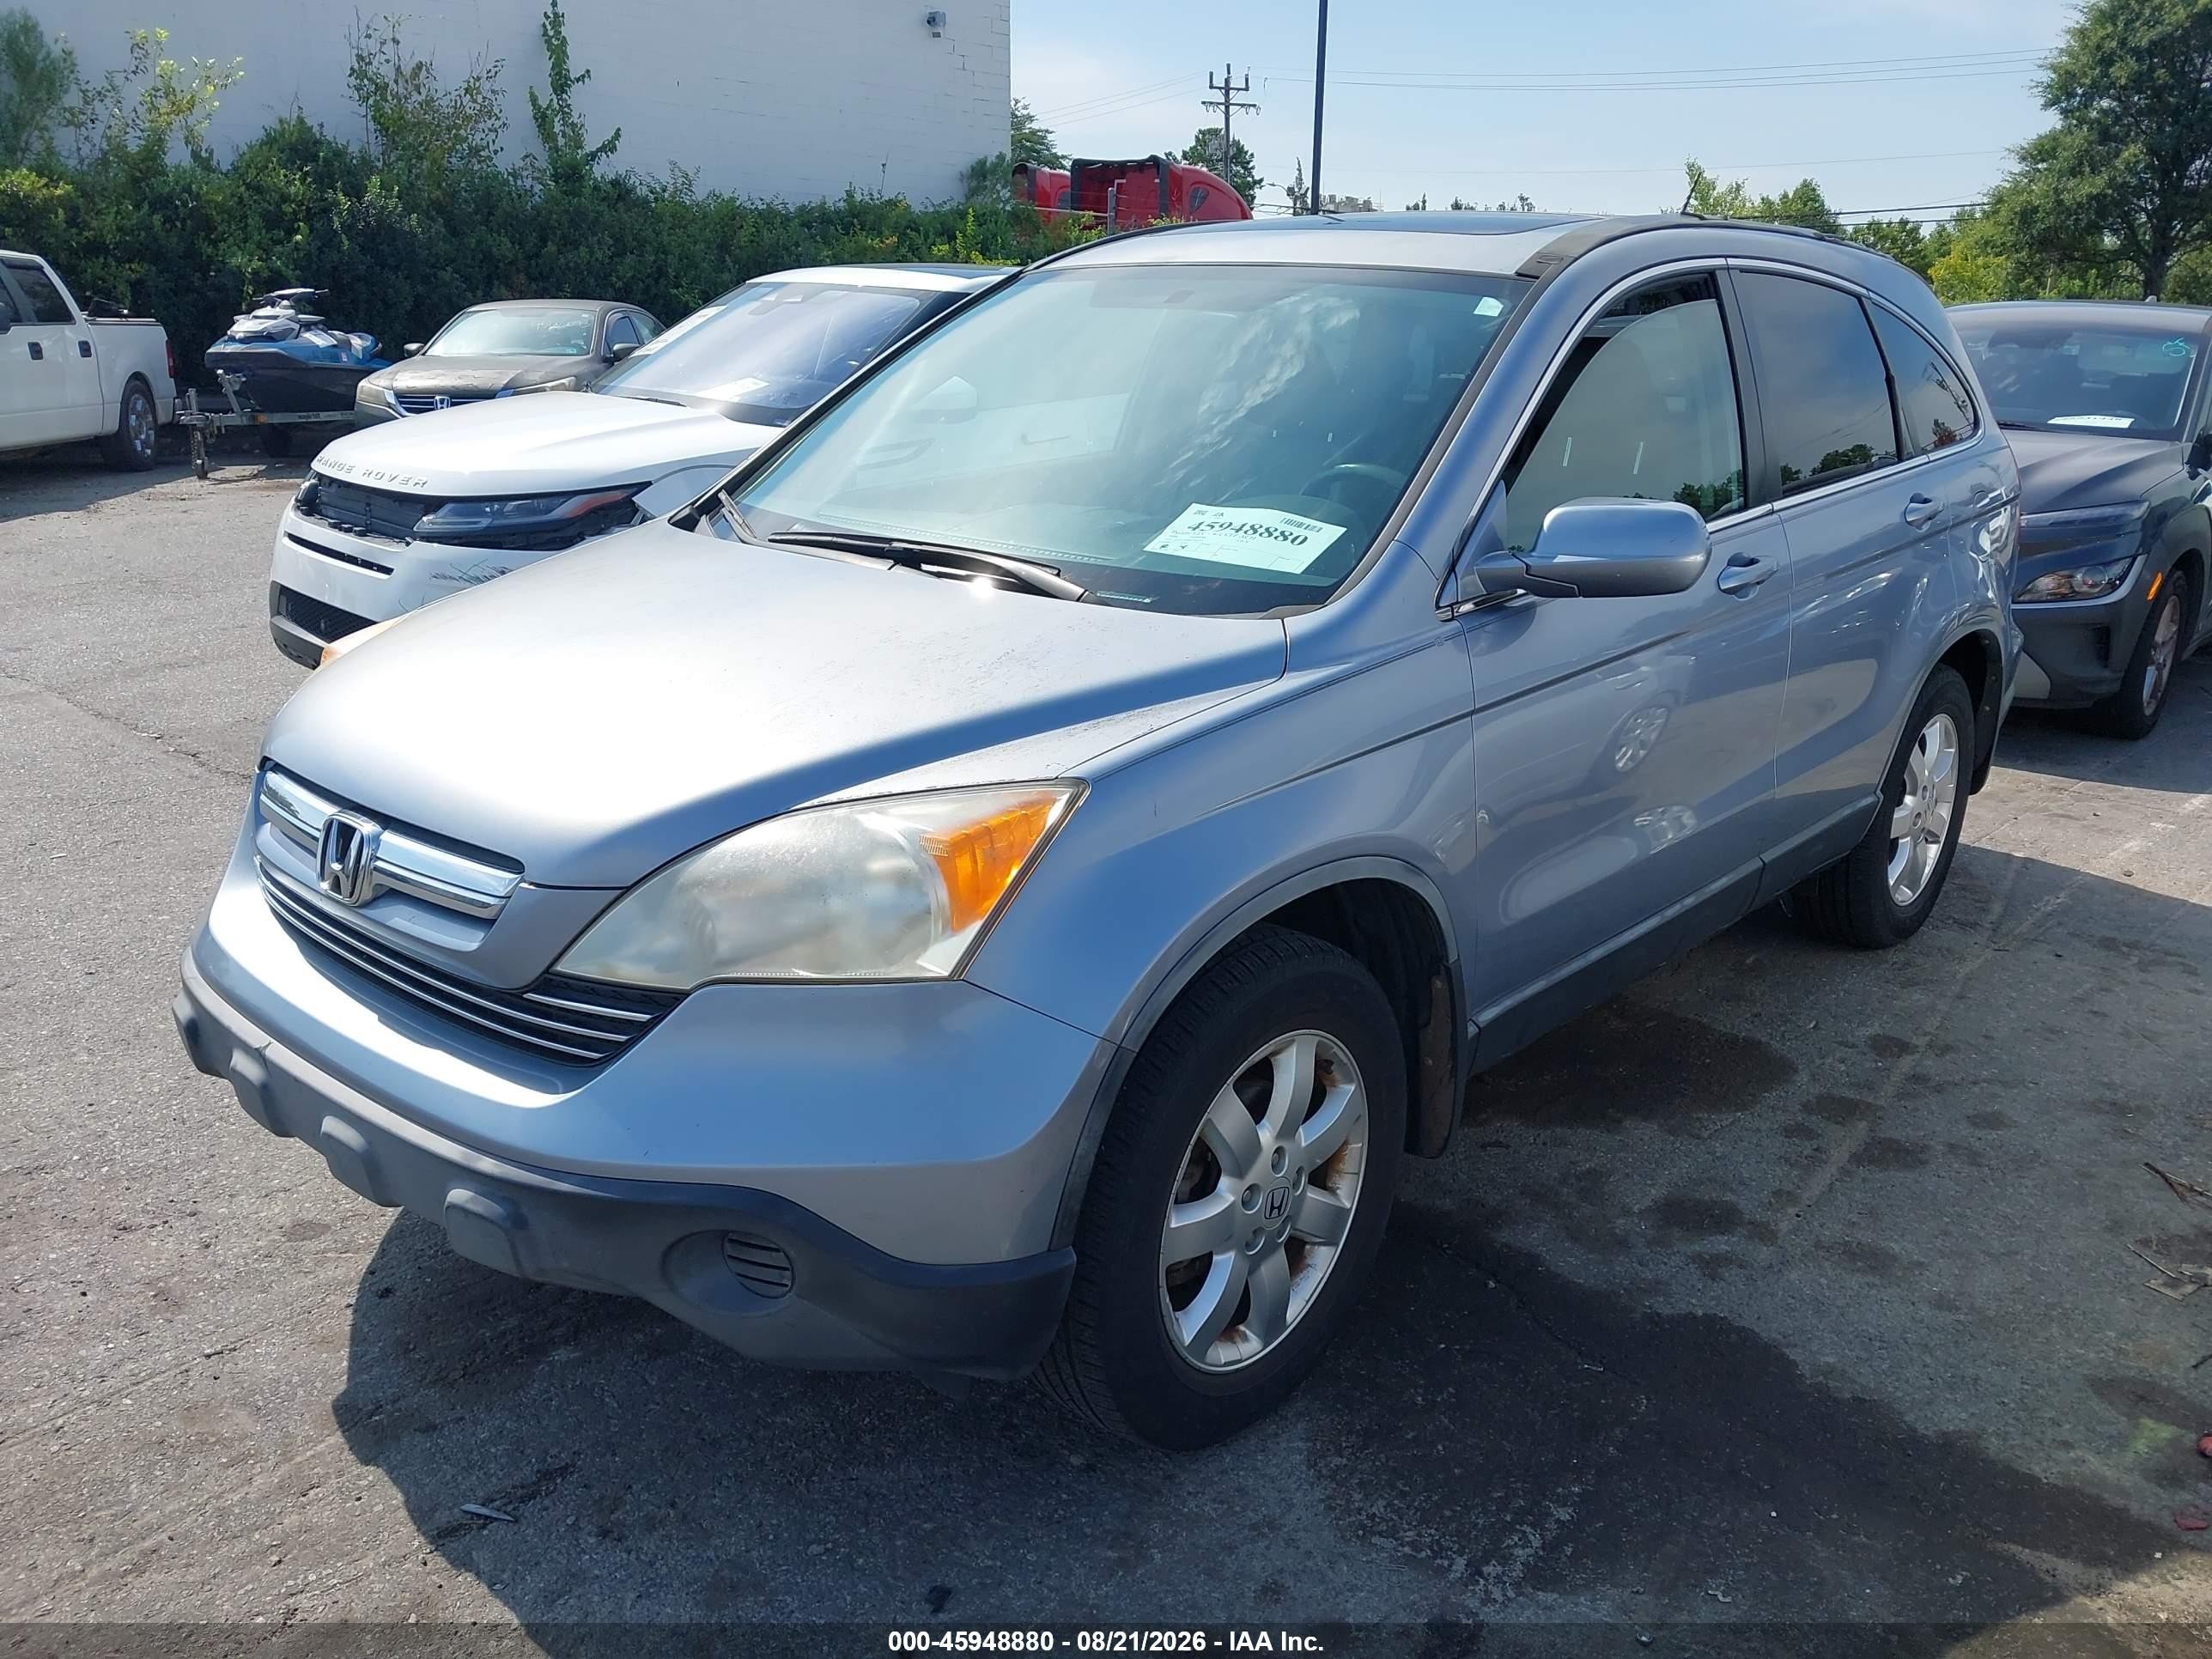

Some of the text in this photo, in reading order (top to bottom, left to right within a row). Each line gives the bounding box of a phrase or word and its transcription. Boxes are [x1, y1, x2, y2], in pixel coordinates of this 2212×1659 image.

[316, 455, 428, 489] RANGE ROVER
[1188, 520, 1309, 546] 45948880
